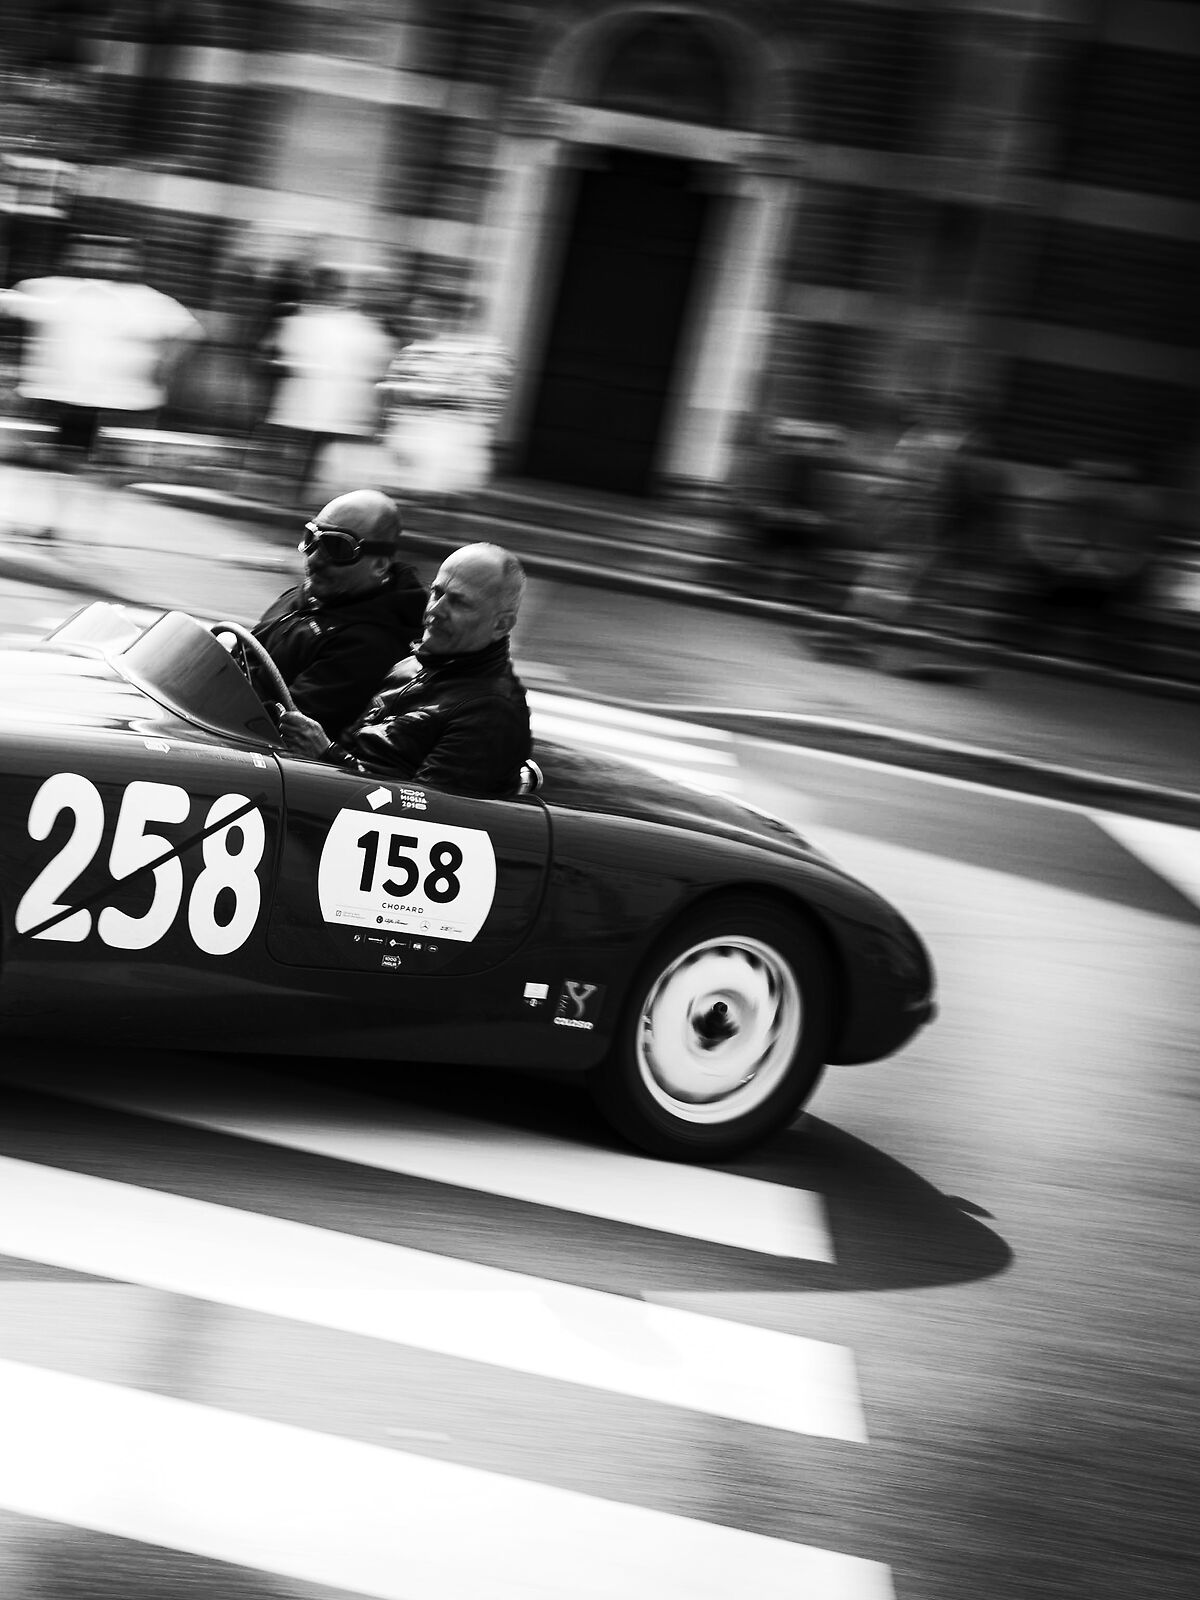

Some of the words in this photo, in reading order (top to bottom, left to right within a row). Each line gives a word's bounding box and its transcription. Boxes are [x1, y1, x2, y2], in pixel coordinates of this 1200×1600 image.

[15, 772, 265, 956] 258
[357, 830, 463, 904] 158
[381, 902, 425, 914] CHOPARD
